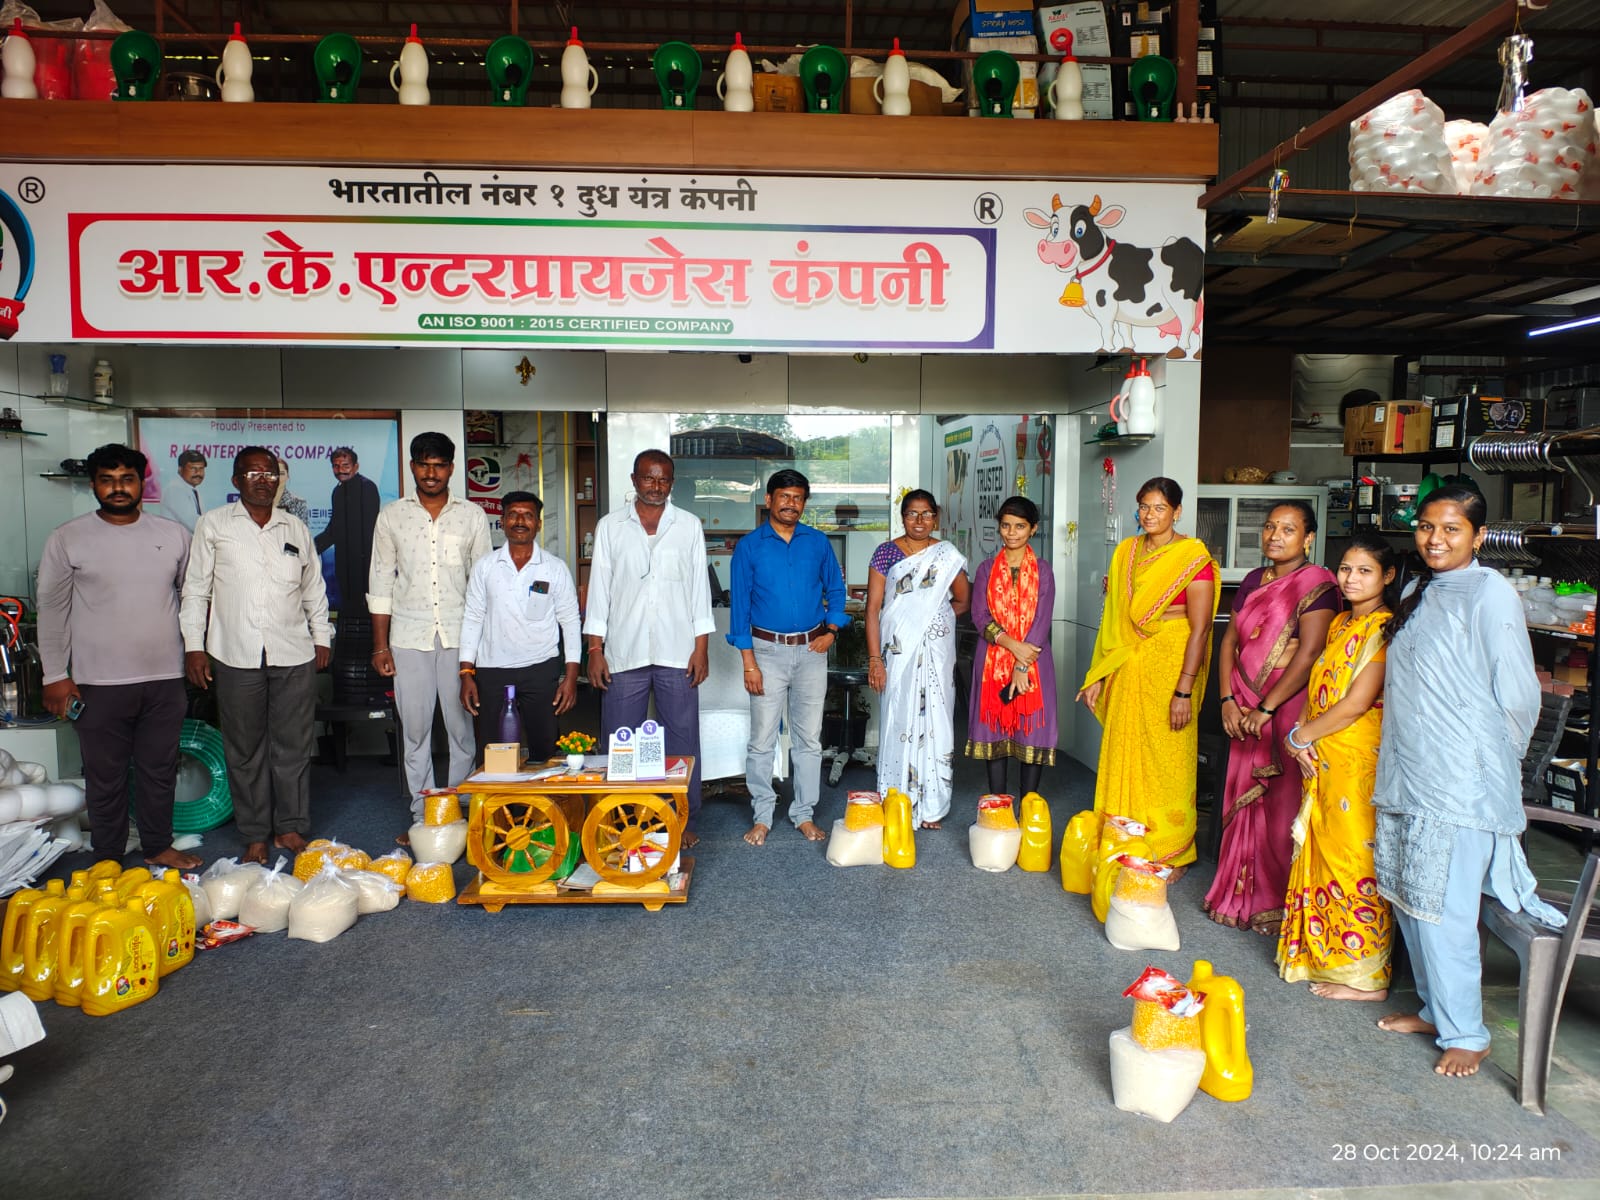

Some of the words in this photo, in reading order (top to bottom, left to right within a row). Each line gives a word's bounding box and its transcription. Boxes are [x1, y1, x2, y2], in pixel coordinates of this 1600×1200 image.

[328, 171, 472, 205] भारतातील
[480, 174, 538, 206] नंबर
[577, 184, 620, 218] दुध
[628, 177, 671, 209] यंत्र
[680, 178, 758, 211] कंपनी
[769, 239, 950, 306] कंपनी
[422, 316, 444, 327] AN
[449, 317, 476, 327] ISO
[481, 317, 514, 328] 9001
[530, 318, 564, 329] 2015
[568, 319, 650, 330] CERTIFIED
[654, 320, 732, 332] COMPANY
[211, 420, 246, 434] Proudly
[248, 420, 294, 432] Presented
[297, 421, 306, 432] to
[170, 444, 178, 458] R
[977, 466, 1003, 491] TRUSTED
